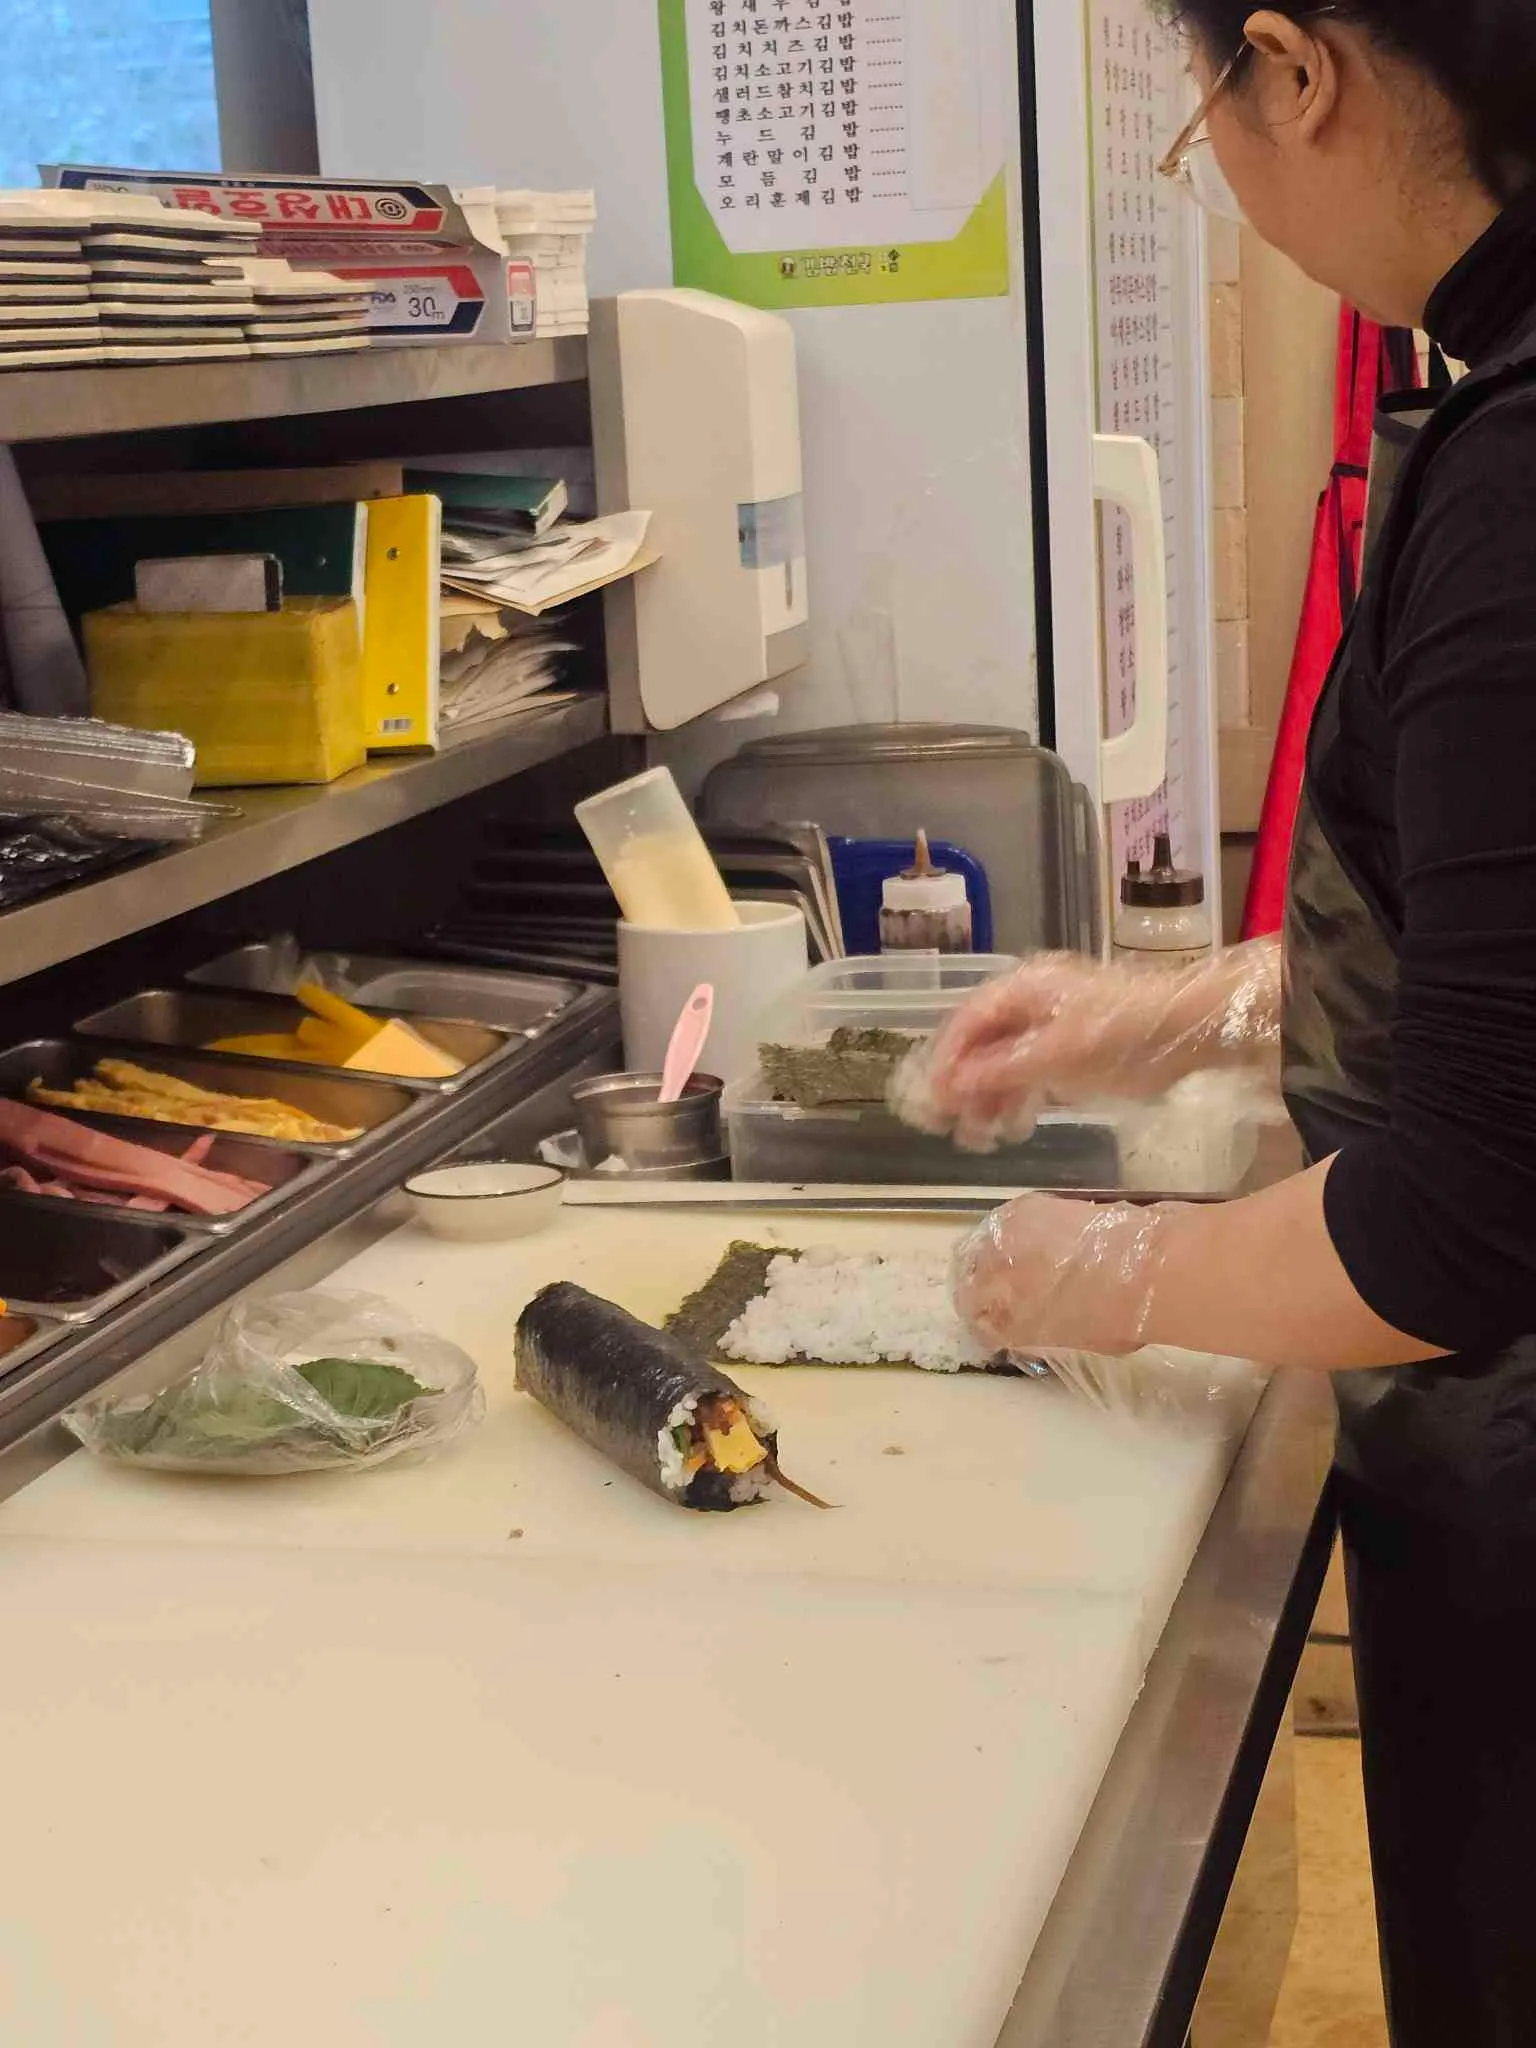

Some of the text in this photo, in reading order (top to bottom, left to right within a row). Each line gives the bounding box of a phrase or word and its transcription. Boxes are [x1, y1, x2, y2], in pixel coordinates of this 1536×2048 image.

[711, 12, 854, 38] 김치돈까스김밥
[712, 34, 855, 60] 김치치즈김밥
[713, 56, 856, 82] 김치소고기김밥
[717, 143, 860, 168] 계란말이김밥
[719, 186, 863, 210] 오리훈제김밥
